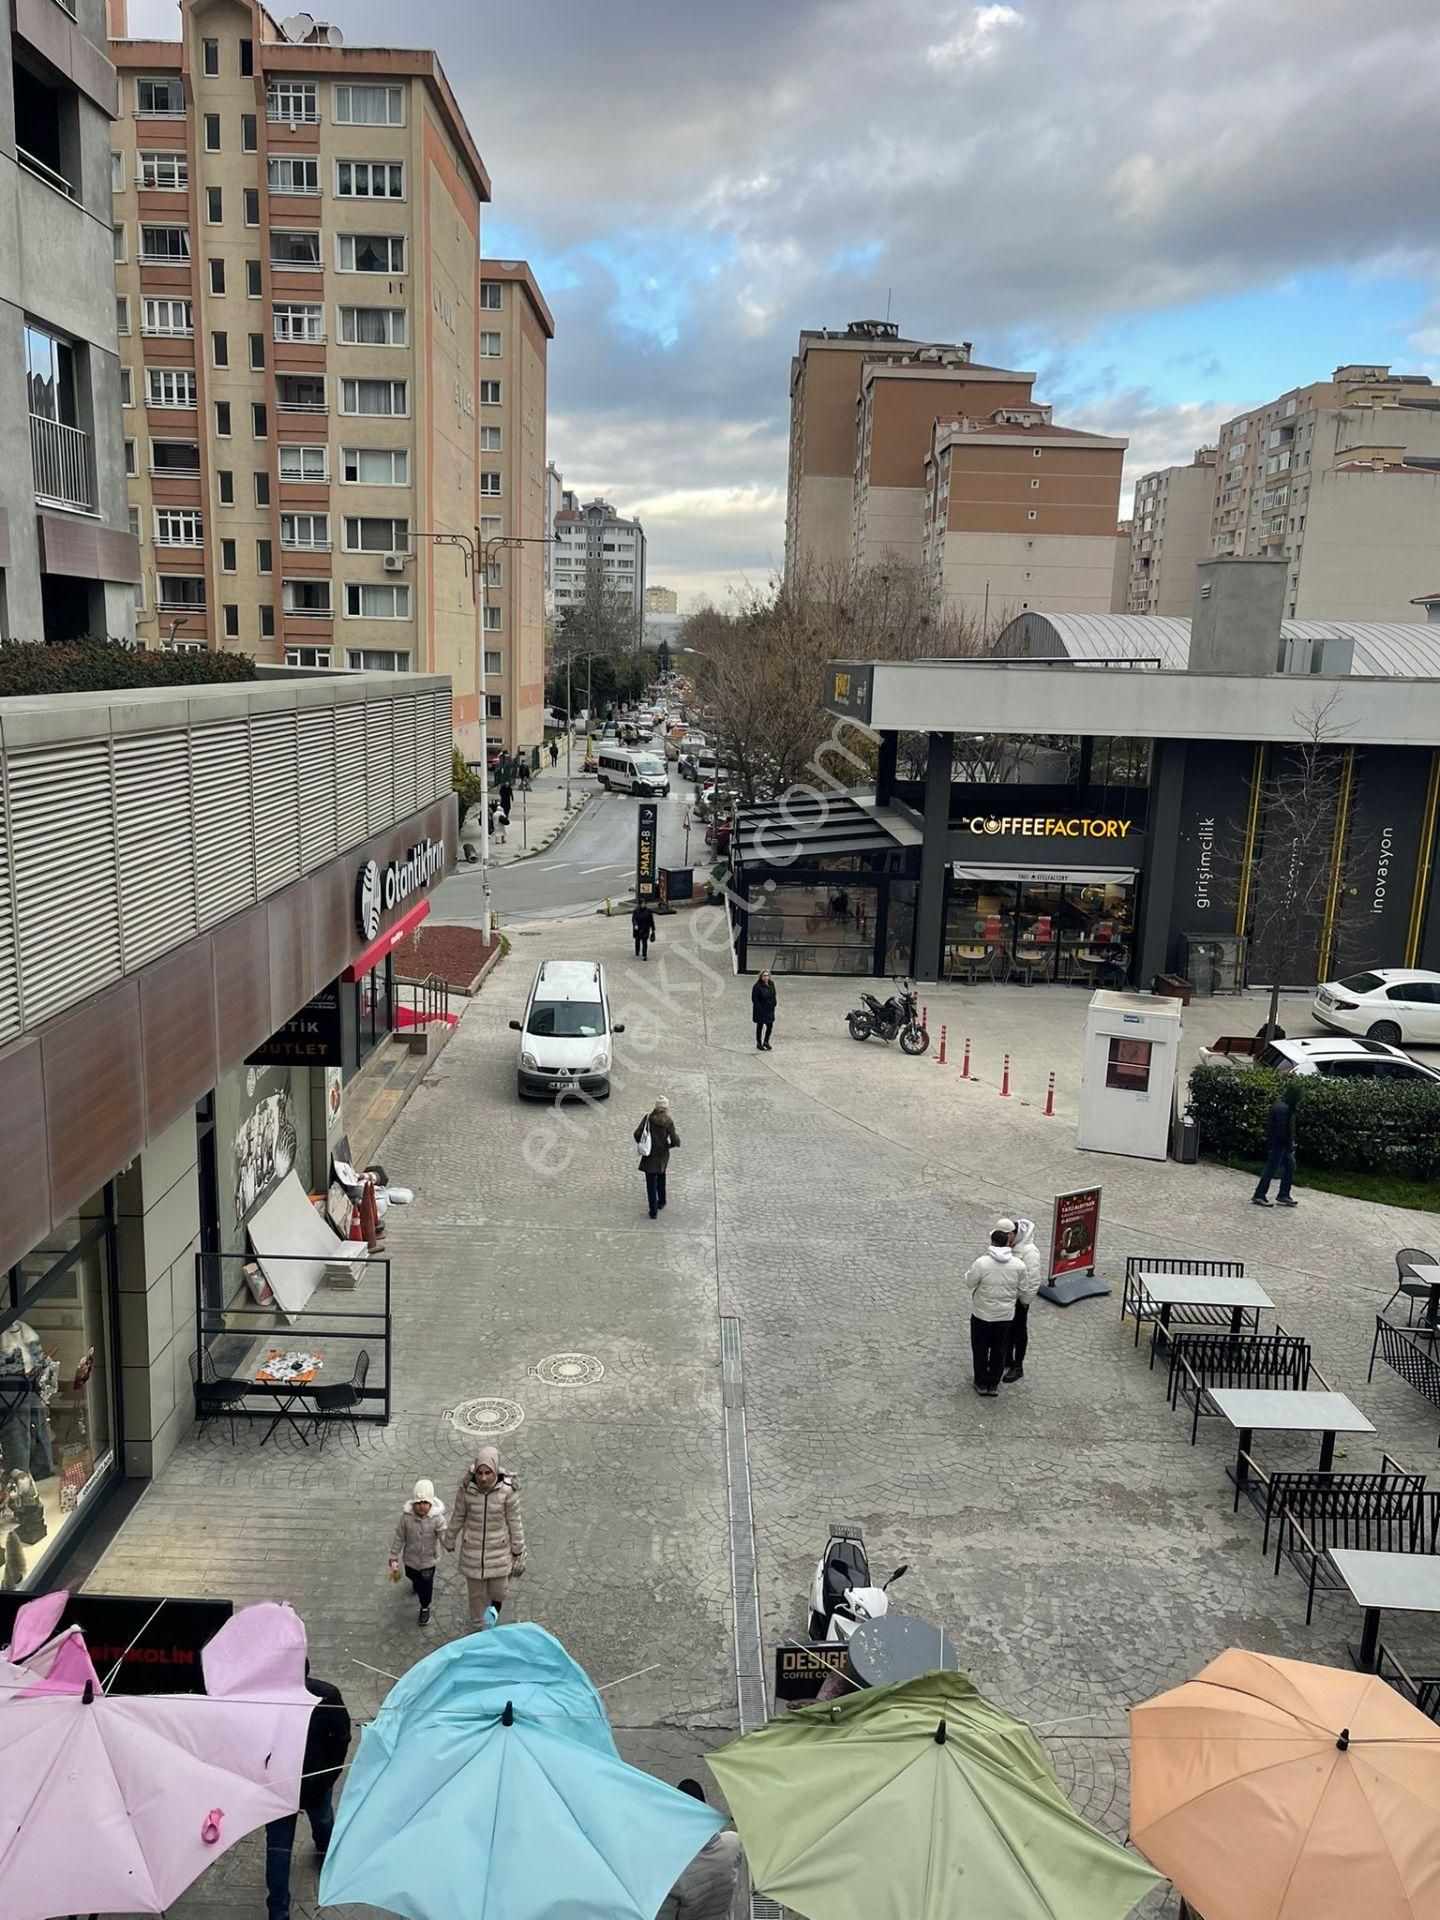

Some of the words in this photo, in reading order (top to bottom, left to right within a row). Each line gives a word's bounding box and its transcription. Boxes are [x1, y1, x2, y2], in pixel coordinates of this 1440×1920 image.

[640, 830, 651, 876] SMART-B
[1195, 817, 1215, 909] girişimcilik
[1370, 827, 1394, 914] inovasyon
[782, 1671, 814, 1679] COFFEE
